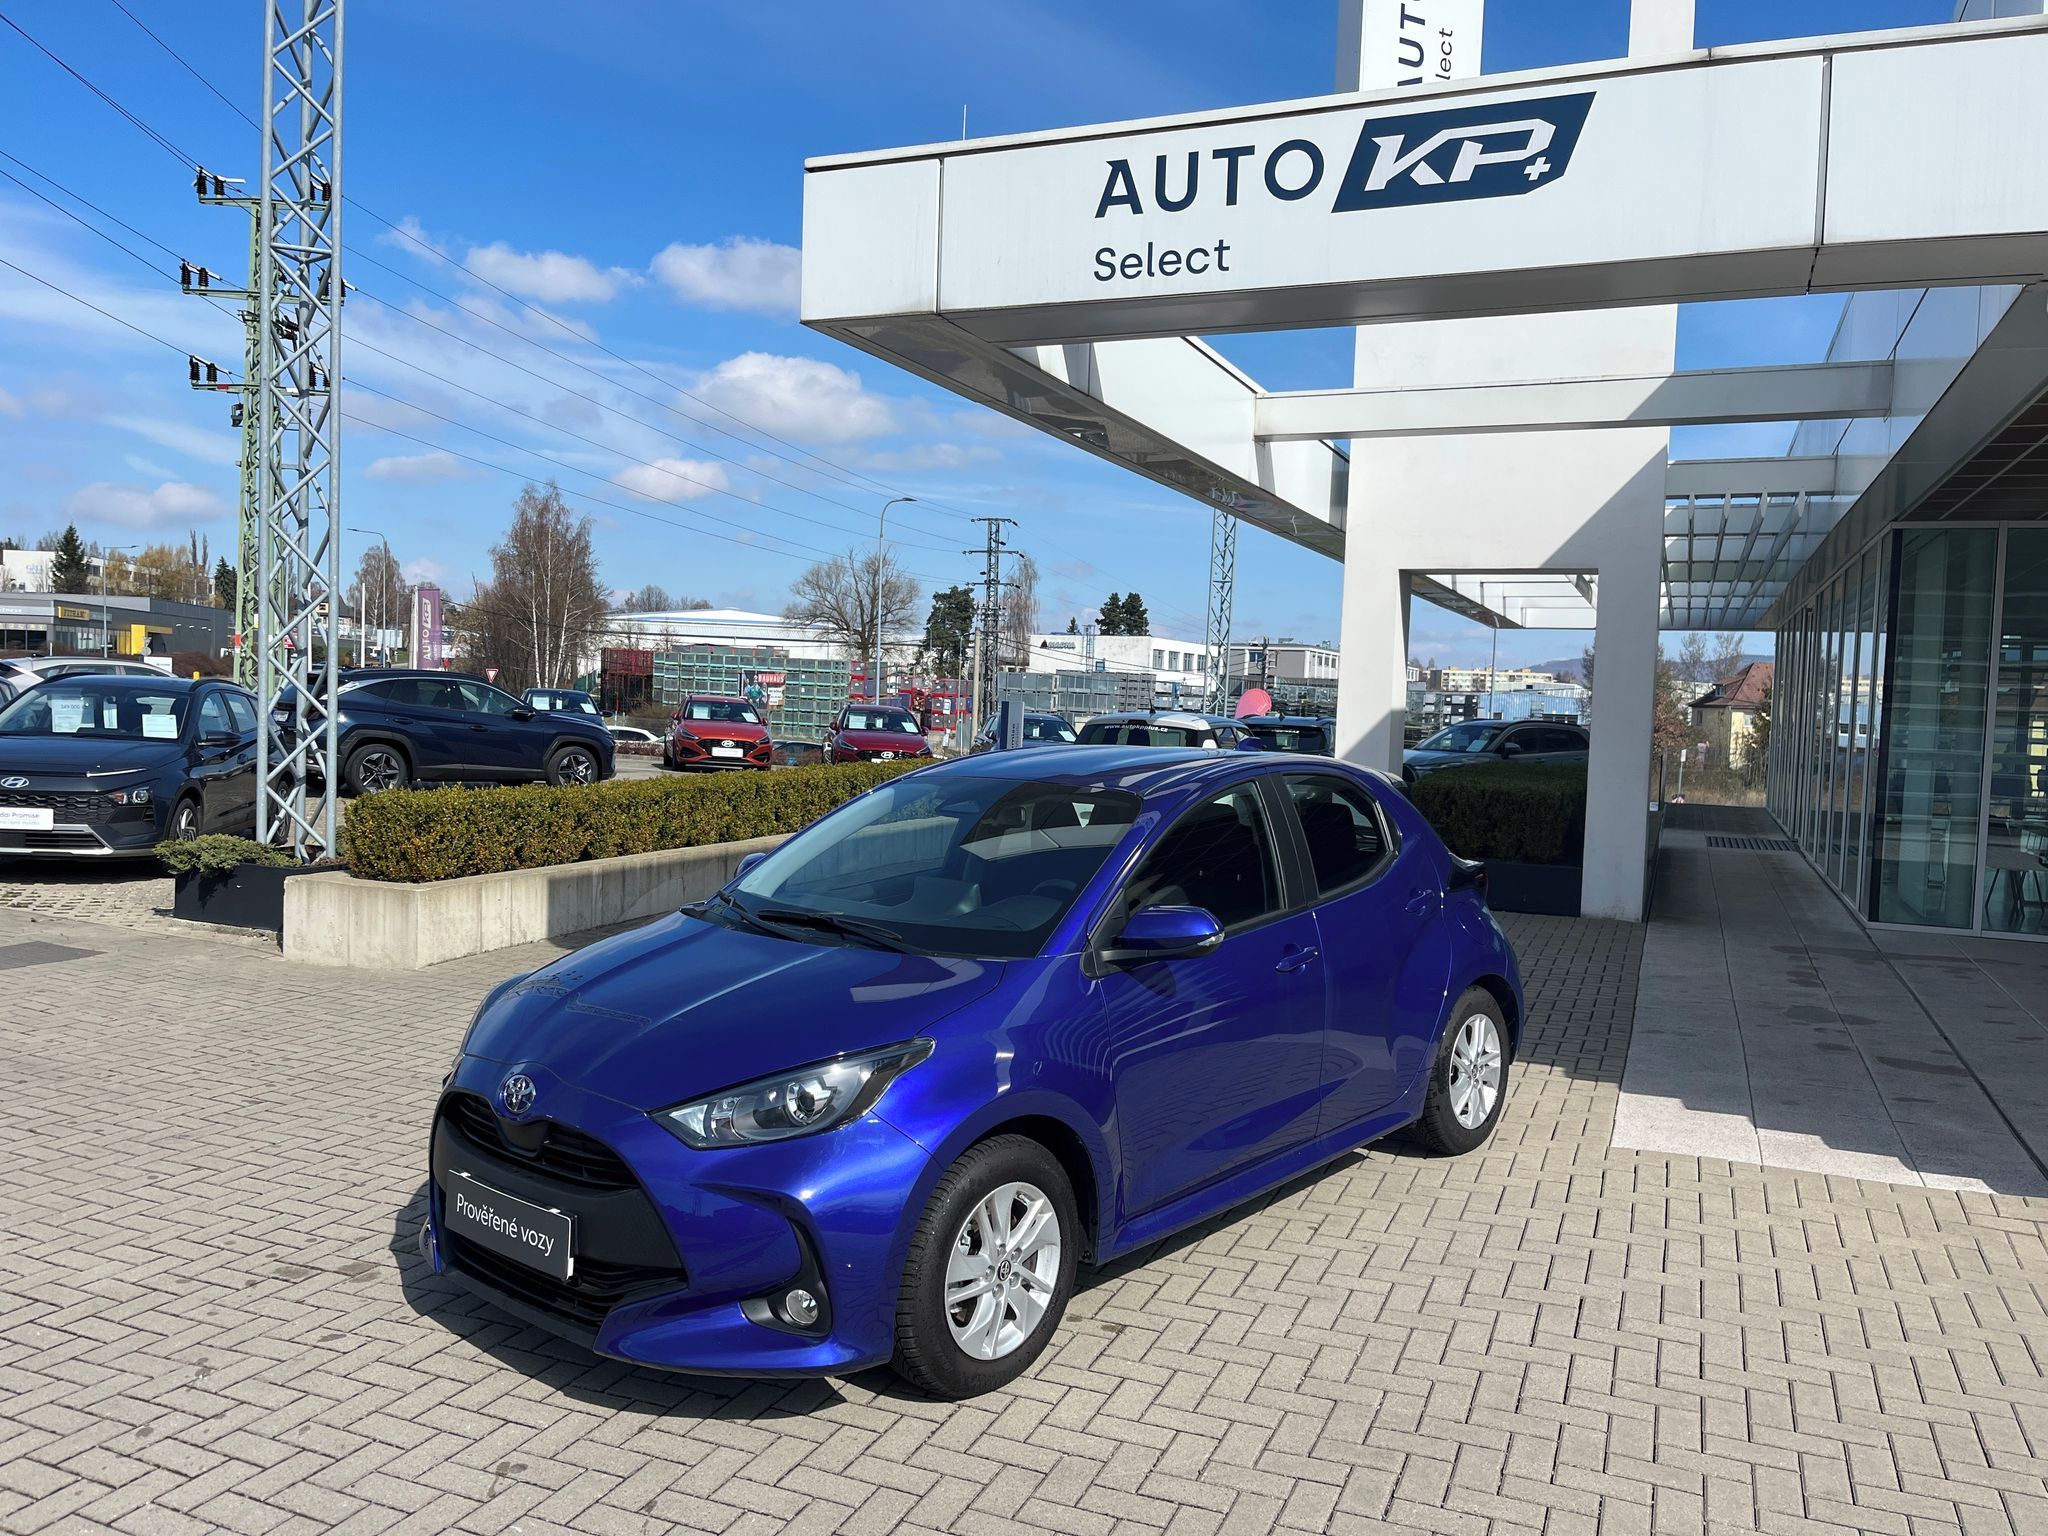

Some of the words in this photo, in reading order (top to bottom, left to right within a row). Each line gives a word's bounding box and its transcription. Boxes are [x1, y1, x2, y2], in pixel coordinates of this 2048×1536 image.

[1397, 0, 1425, 86] UT
[1435, 28, 1453, 80] lect
[1095, 139, 1324, 218] AUTO
[1093, 239, 1231, 282] Select
[423, 629, 432, 660] AUTO
[456, 1193, 518, 1238] Prověřené
[521, 1226, 554, 1256] vozy
